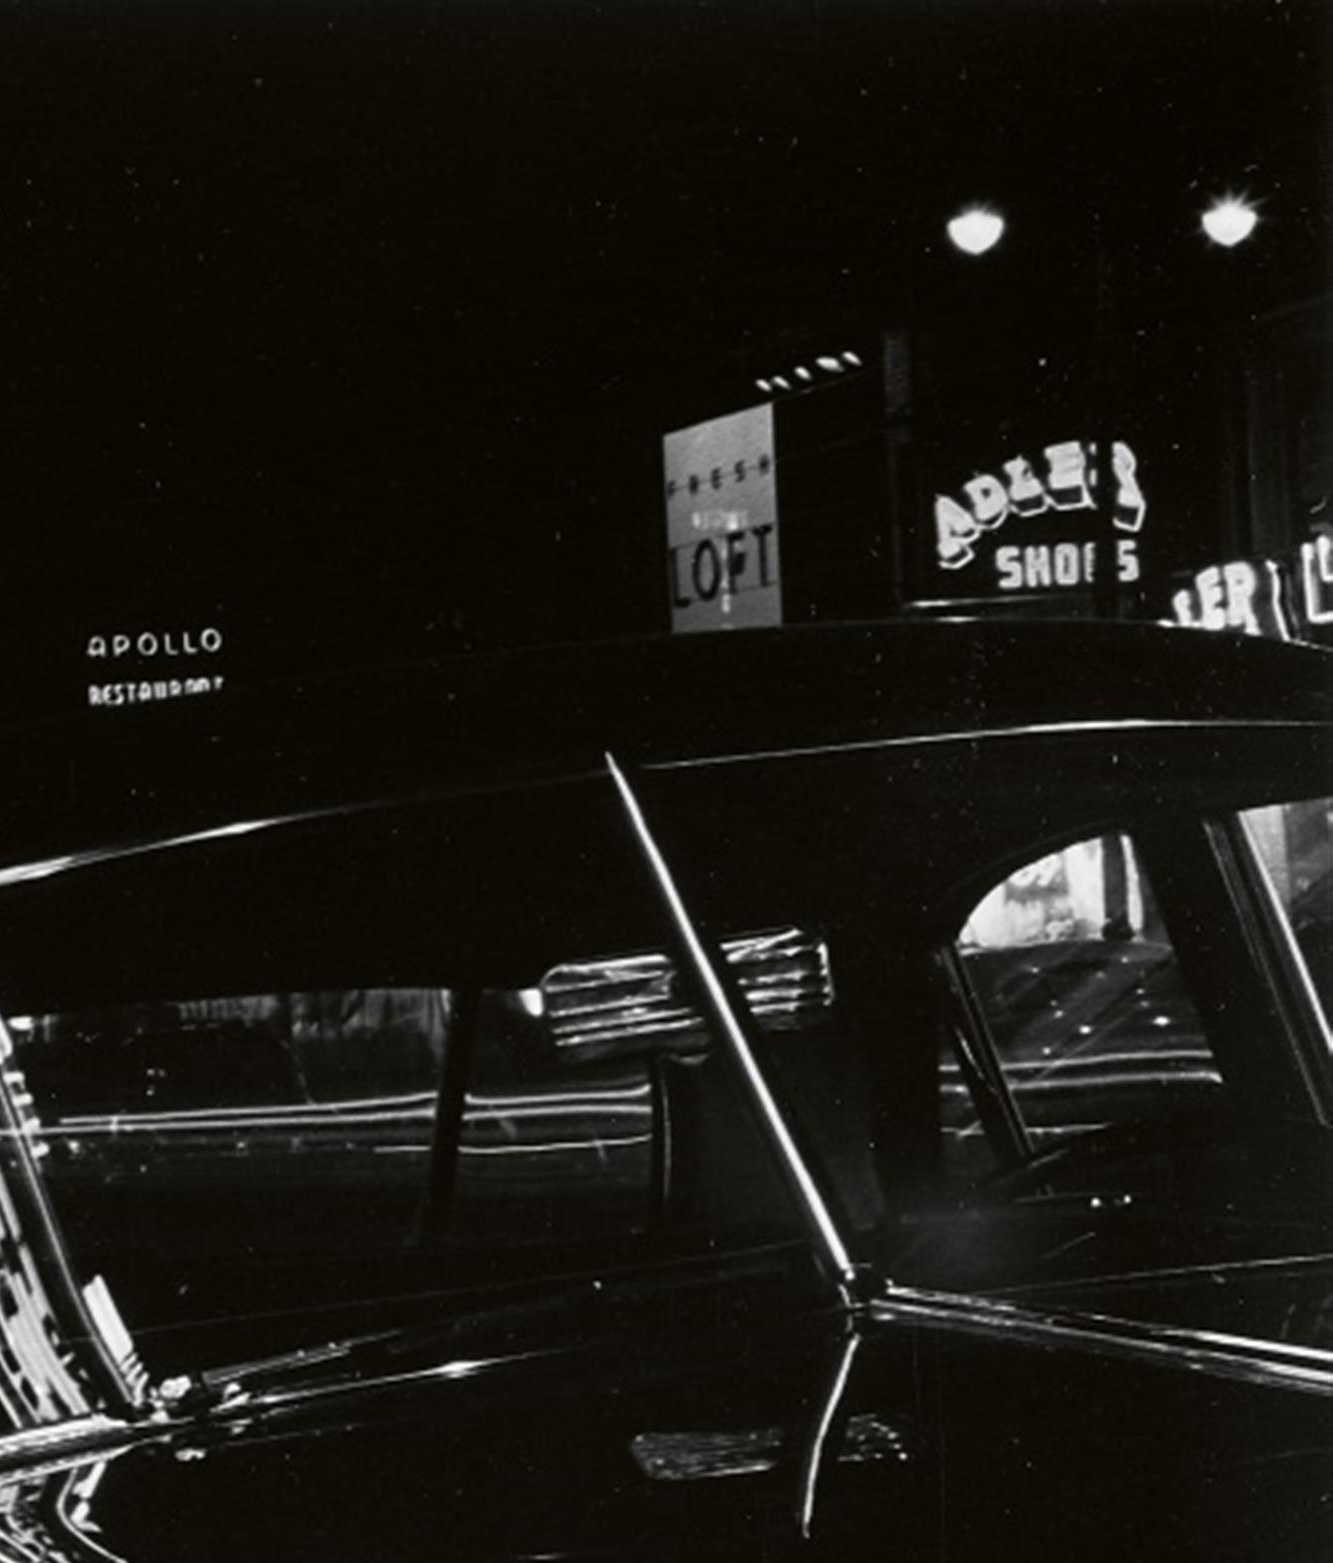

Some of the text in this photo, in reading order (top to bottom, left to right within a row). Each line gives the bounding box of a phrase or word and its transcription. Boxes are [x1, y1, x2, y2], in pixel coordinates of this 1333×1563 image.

[667, 453, 772, 498] FRESH
[670, 524, 773, 609] LOFT
[87, 627, 223, 657] APOLLO
[88, 675, 224, 705] RESTAURANT
